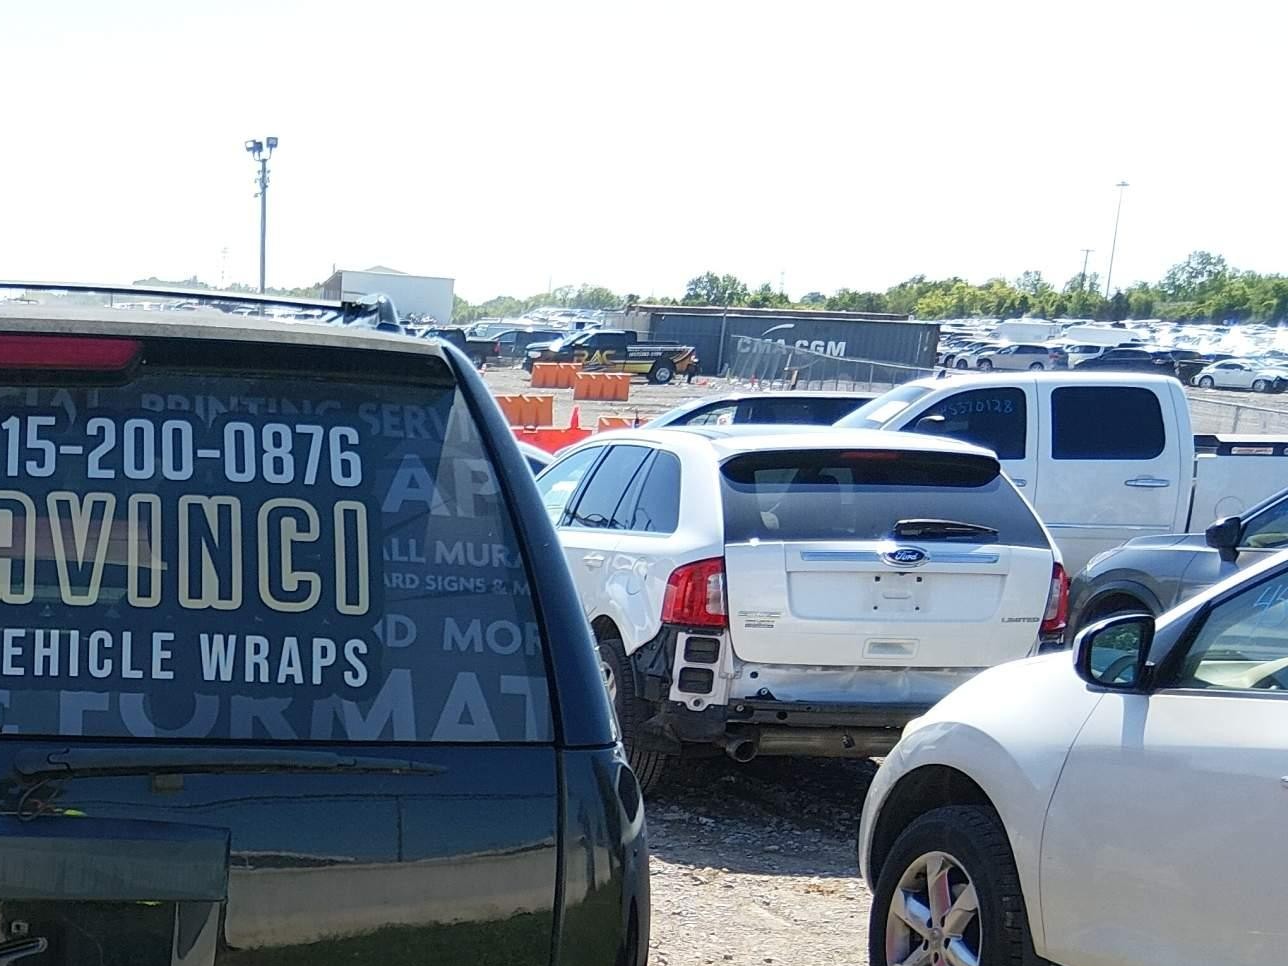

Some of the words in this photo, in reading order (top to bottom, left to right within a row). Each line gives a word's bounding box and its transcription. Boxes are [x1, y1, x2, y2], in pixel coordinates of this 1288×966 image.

[795, 339, 846, 357] CGM
[895, 551, 919, 561] Ford
[424, 575, 487, 593] SIGNS
[199, 632, 369, 688] WRAPS
